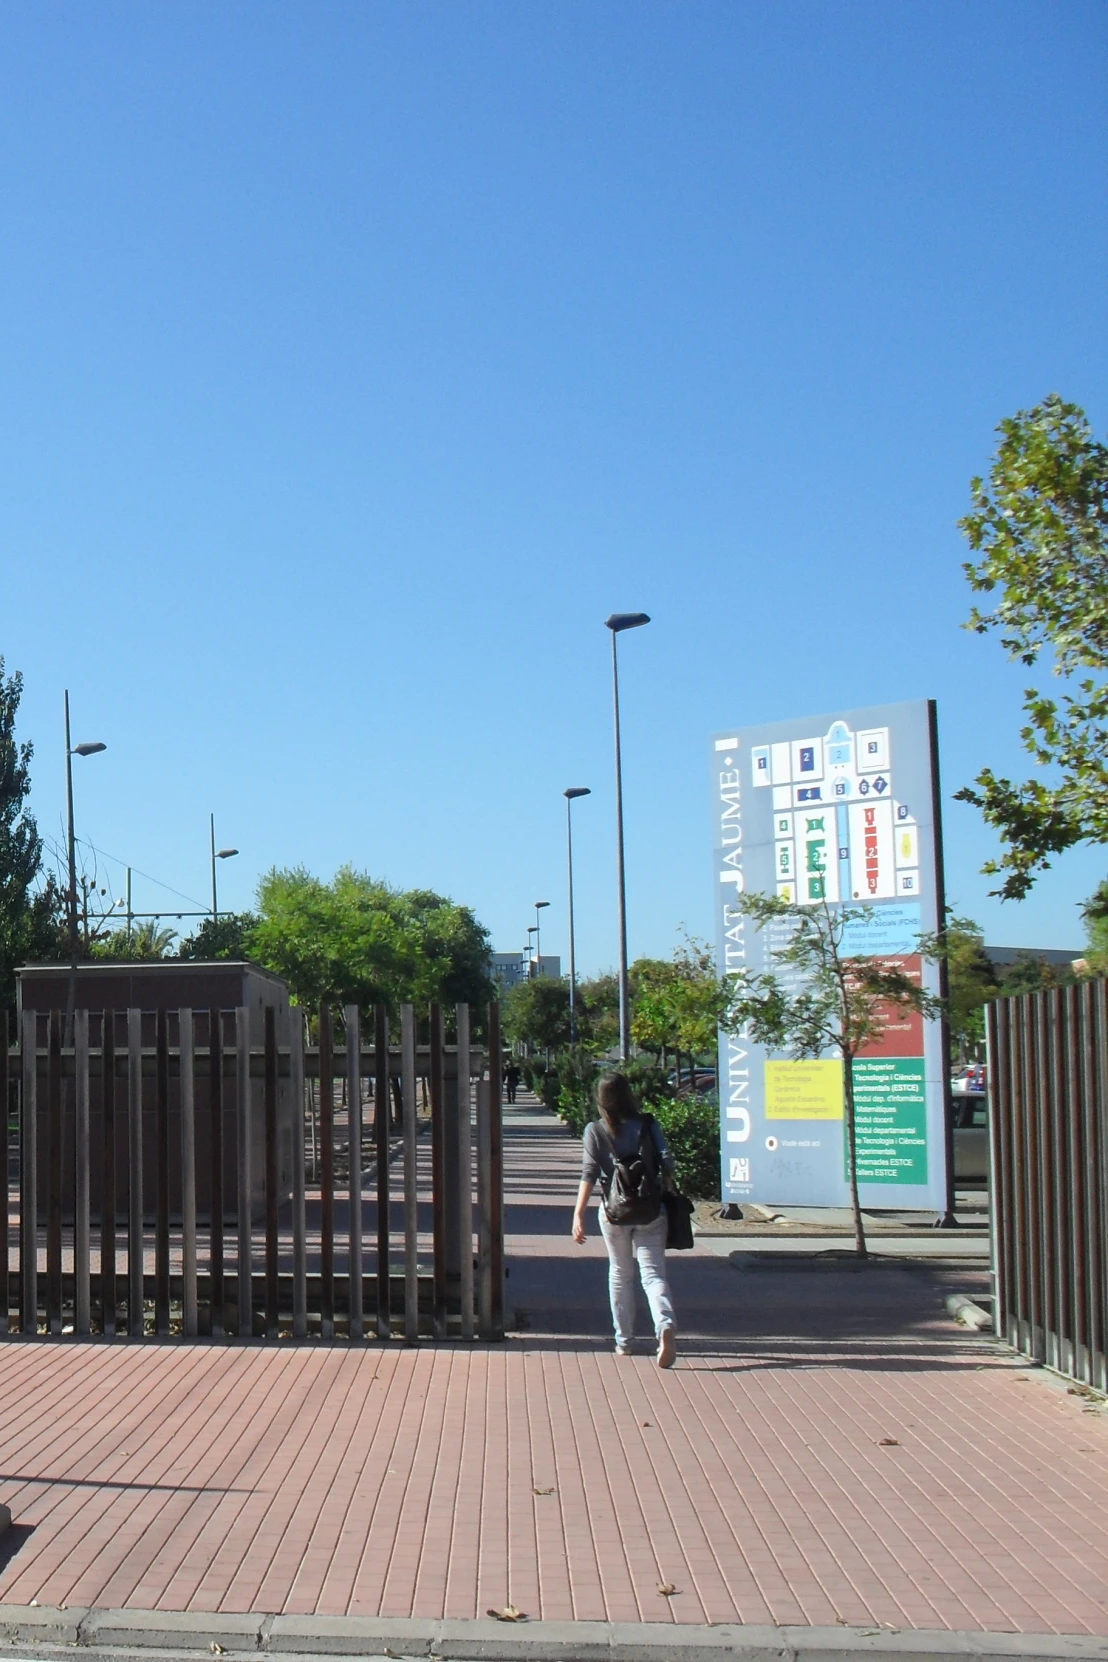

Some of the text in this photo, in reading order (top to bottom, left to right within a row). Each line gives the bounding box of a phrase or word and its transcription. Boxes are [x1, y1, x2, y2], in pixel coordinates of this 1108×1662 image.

[869, 743, 877, 752] 3
[803, 752, 811, 762] 2
[836, 750, 843, 759] 2
[760, 759, 765, 768] 1
[836, 785, 844, 794] 5
[860, 782, 868, 792] 6
[876, 780, 884, 790] 7
[805, 789, 813, 799] 4
[867, 811, 872, 820] 1
[899, 806, 907, 817] 8
[780, 821, 788, 830] 4
[811, 821, 817, 829] 1
[840, 849, 848, 858] 9
[868, 847, 875, 857] 2
[781, 855, 788, 865] 5
[812, 852, 819, 862] 2
[813, 882, 820, 892] 3
[869, 878, 876, 888] 3
[902, 878, 913, 888] 10
[892, 1083, 919, 1092] (ESTCE)
[889, 1158, 914, 1167] ESTCE
[874, 1168, 898, 1176] ESTCE
